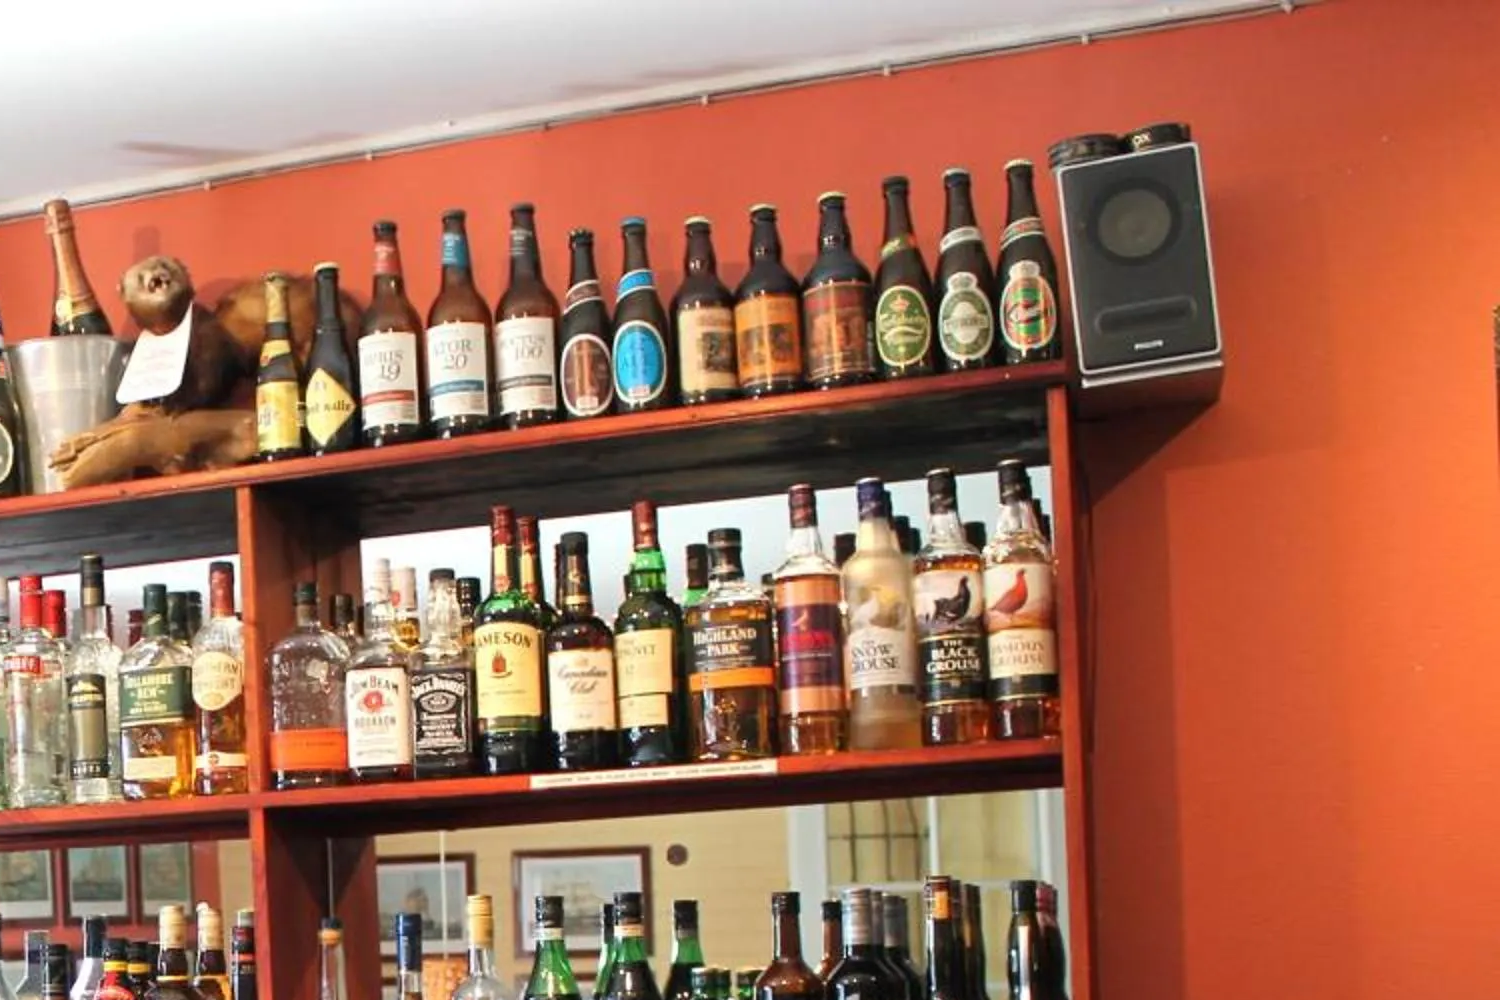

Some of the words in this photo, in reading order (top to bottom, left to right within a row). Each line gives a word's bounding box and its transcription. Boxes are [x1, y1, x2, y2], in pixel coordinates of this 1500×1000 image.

[379, 362, 402, 383] 19
[472, 630, 534, 650] JAMESON
[693, 627, 757, 646] HIGHLAND
[707, 642, 740, 657] PARK
[930, 645, 976, 661] BLACK
[926, 657, 981, 674] GROUSE
[369, 675, 400, 695] BEAM
